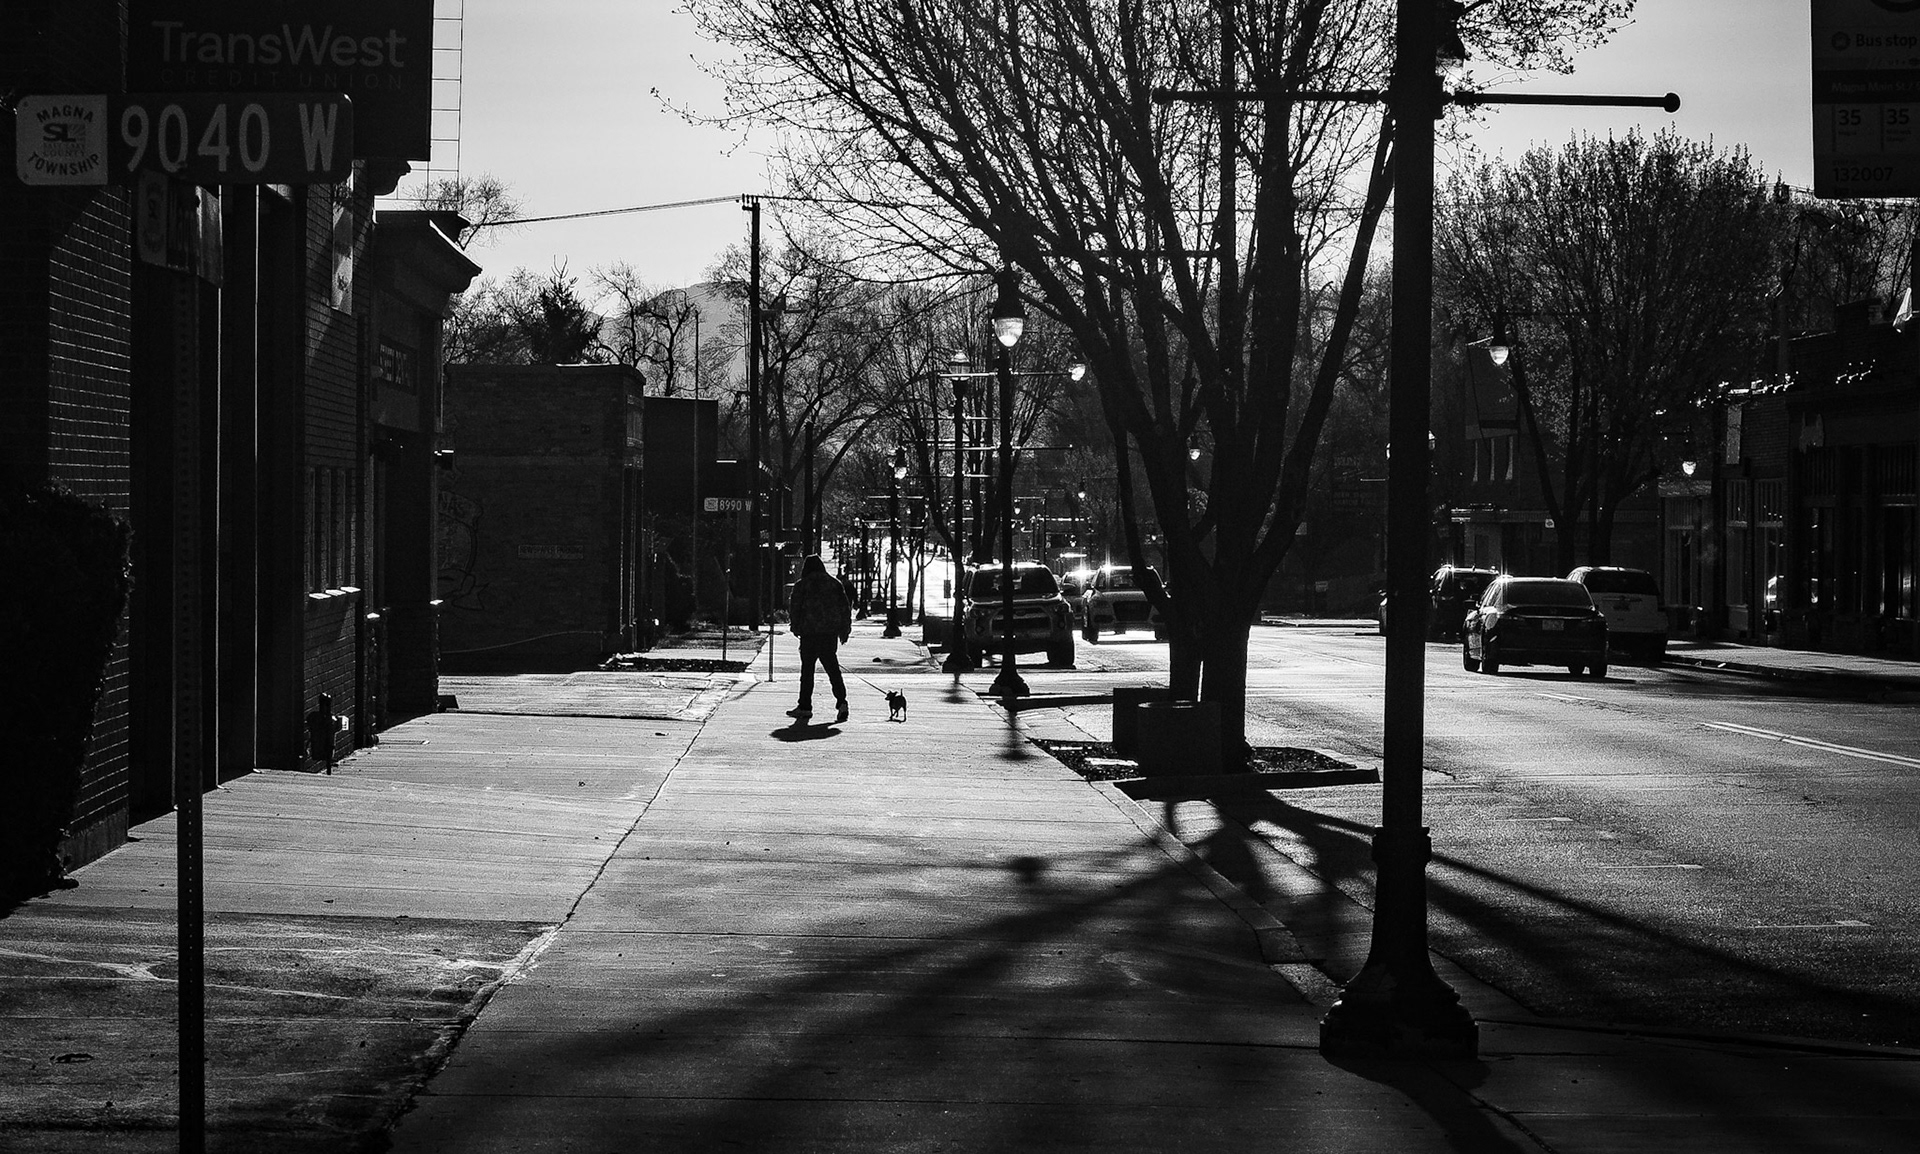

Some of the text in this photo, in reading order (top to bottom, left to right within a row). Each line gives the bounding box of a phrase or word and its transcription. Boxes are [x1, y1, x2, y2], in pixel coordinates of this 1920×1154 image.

[151, 20, 407, 68] TransWest
[1856, 33, 1918, 49] Bus stop
[161, 68, 401, 89] CREDIT UNION
[1868, 82, 1893, 91] Main
[36, 105, 94, 123] MAGNA
[1838, 109, 1861, 126] 35
[1886, 108, 1910, 125] 35
[120, 103, 338, 173] 9040 W
[27, 151, 100, 176] TOWNSHIP
[1833, 167, 1894, 182] 132007
[719, 499, 752, 512] 8990 W
